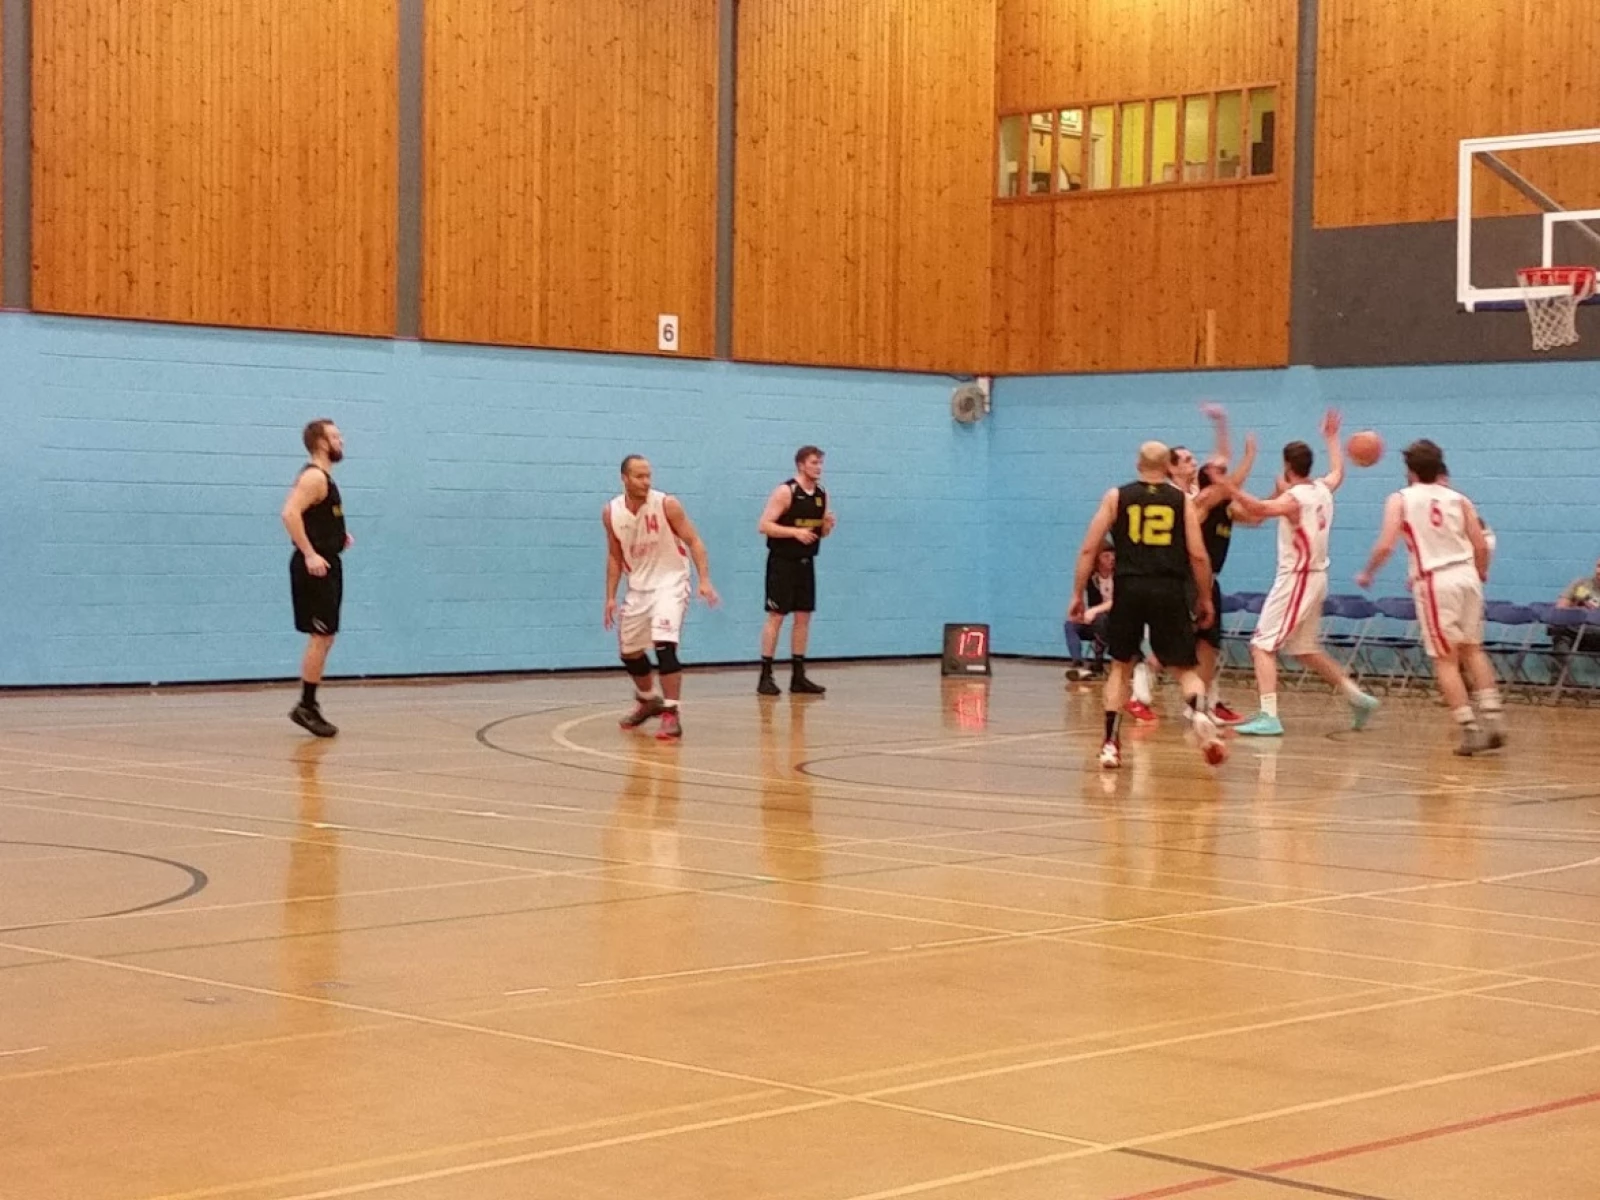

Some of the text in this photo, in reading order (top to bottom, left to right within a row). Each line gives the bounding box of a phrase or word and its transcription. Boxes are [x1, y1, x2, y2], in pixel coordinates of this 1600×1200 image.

[663, 323, 675, 342] 6
[645, 513, 659, 534] 14
[1126, 503, 1175, 546] 12
[959, 631, 984, 656] 17
